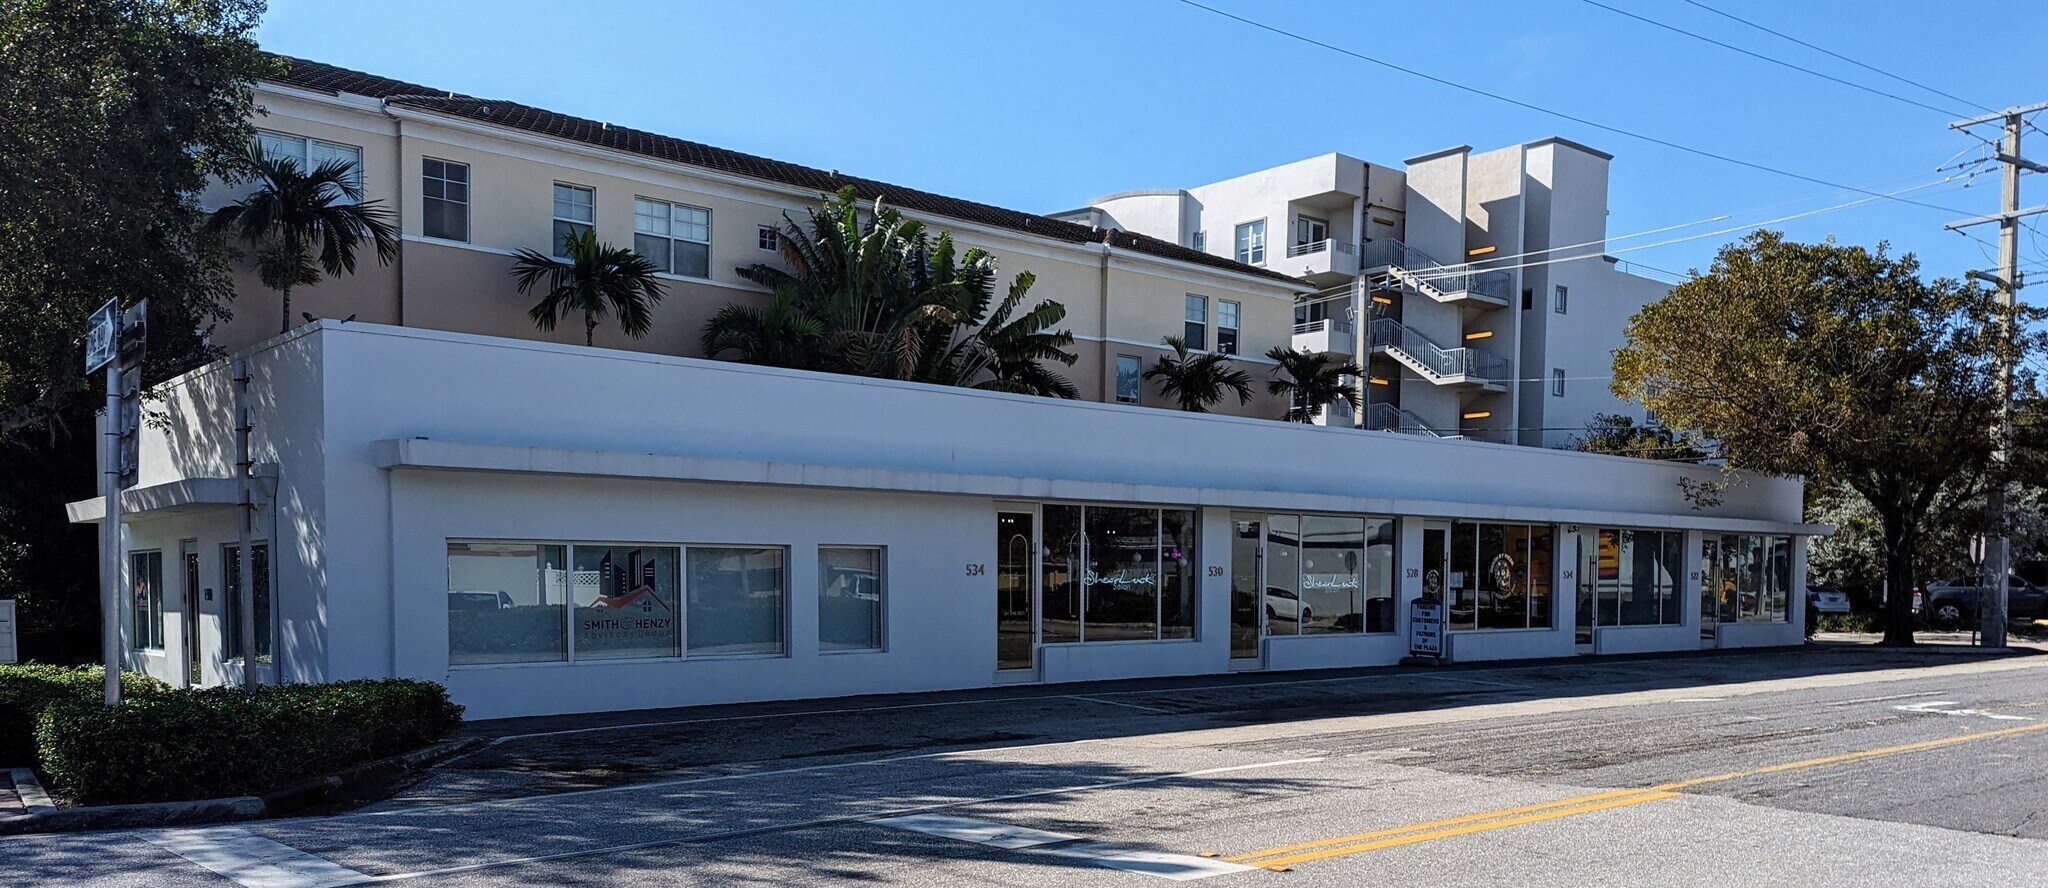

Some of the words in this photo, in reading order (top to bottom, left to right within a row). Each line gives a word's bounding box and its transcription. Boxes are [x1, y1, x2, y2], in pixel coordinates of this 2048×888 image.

[966, 564, 984, 576] 534
[1208, 566, 1223, 577] 530
[1406, 568, 1419, 578] 528
[1416, 603, 1436, 611] PARKING
[584, 619, 618, 630] SMITH
[635, 618, 671, 629] HENZY
[584, 631, 636, 640] ADVISORY
[638, 630, 672, 638] GROUP
